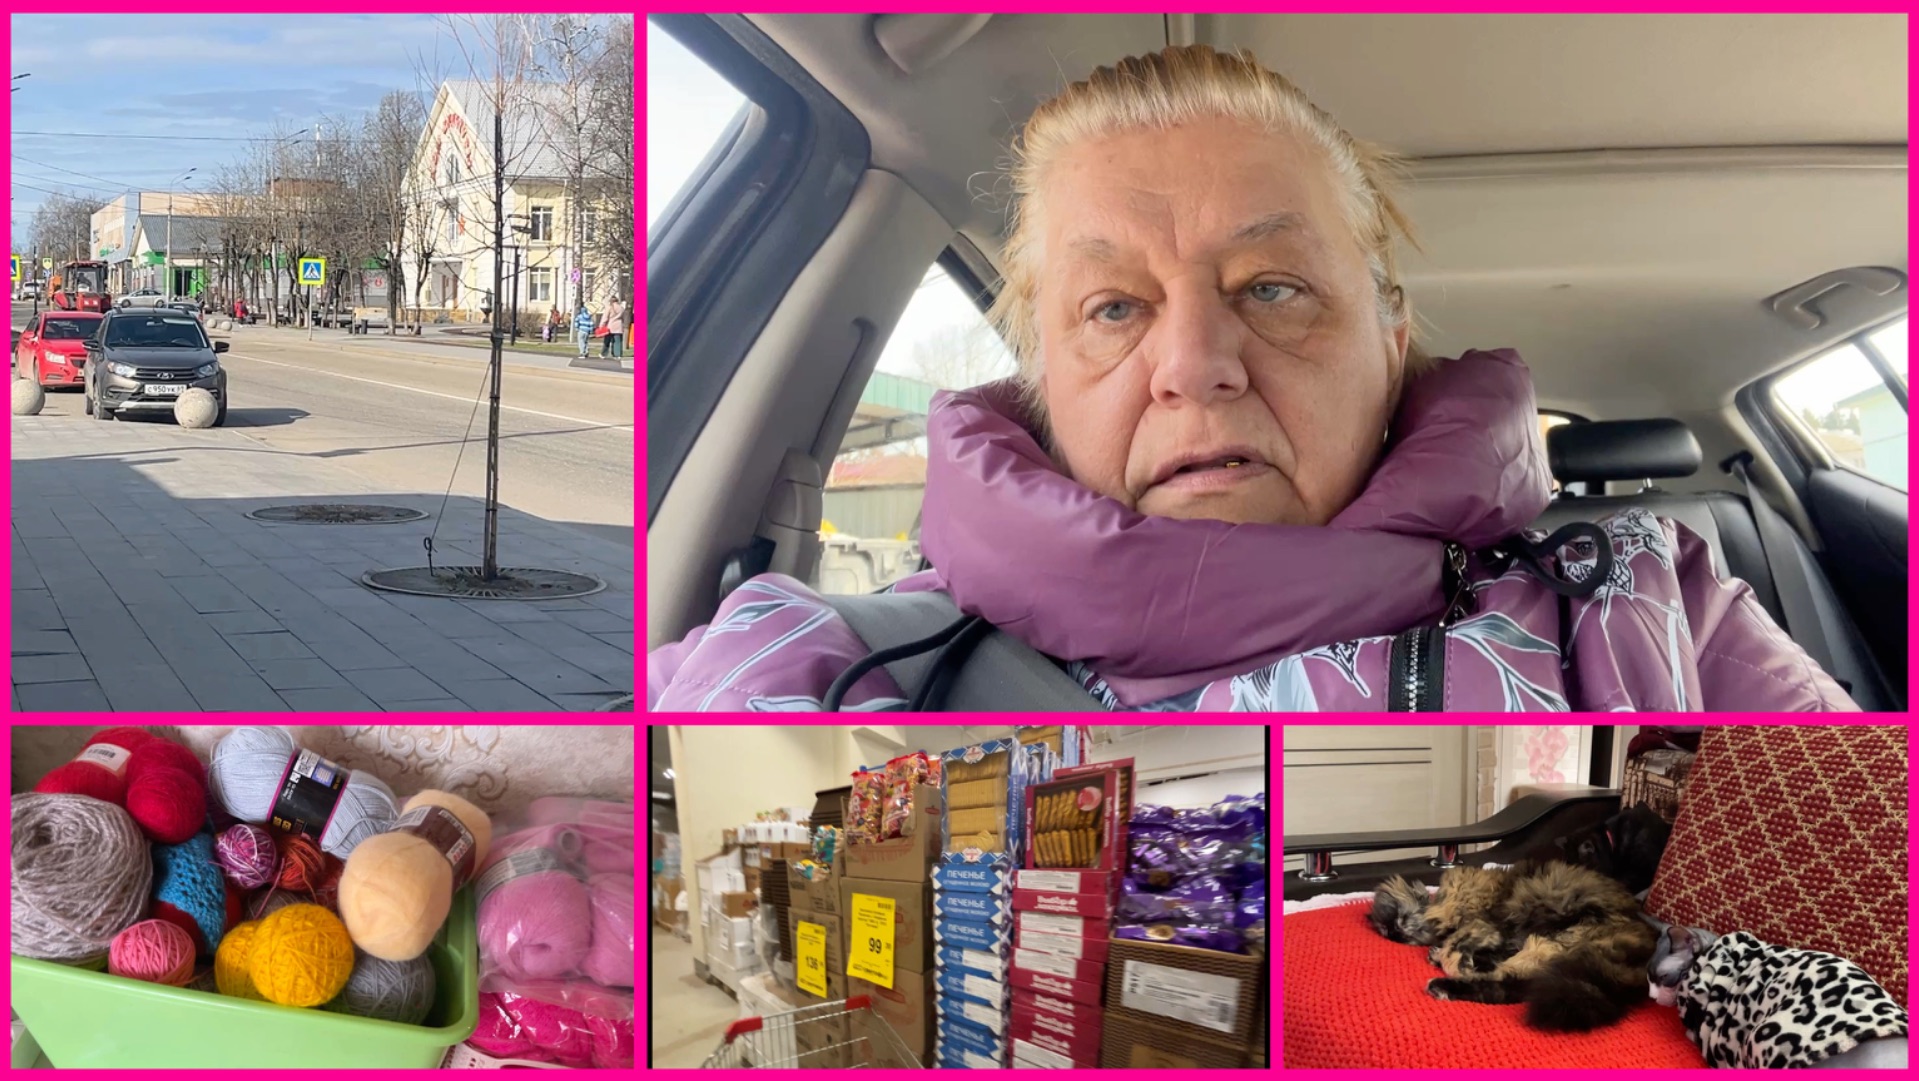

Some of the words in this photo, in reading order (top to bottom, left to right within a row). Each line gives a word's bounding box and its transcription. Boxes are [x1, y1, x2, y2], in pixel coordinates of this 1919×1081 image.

[946, 869, 986, 880] ПЕЧЕНЬЕ
[947, 897, 986, 909] ПЕЧЕНЬЕ
[947, 923, 985, 938] ПЕЧЕНЬЕ
[868, 937, 882, 954] 99
